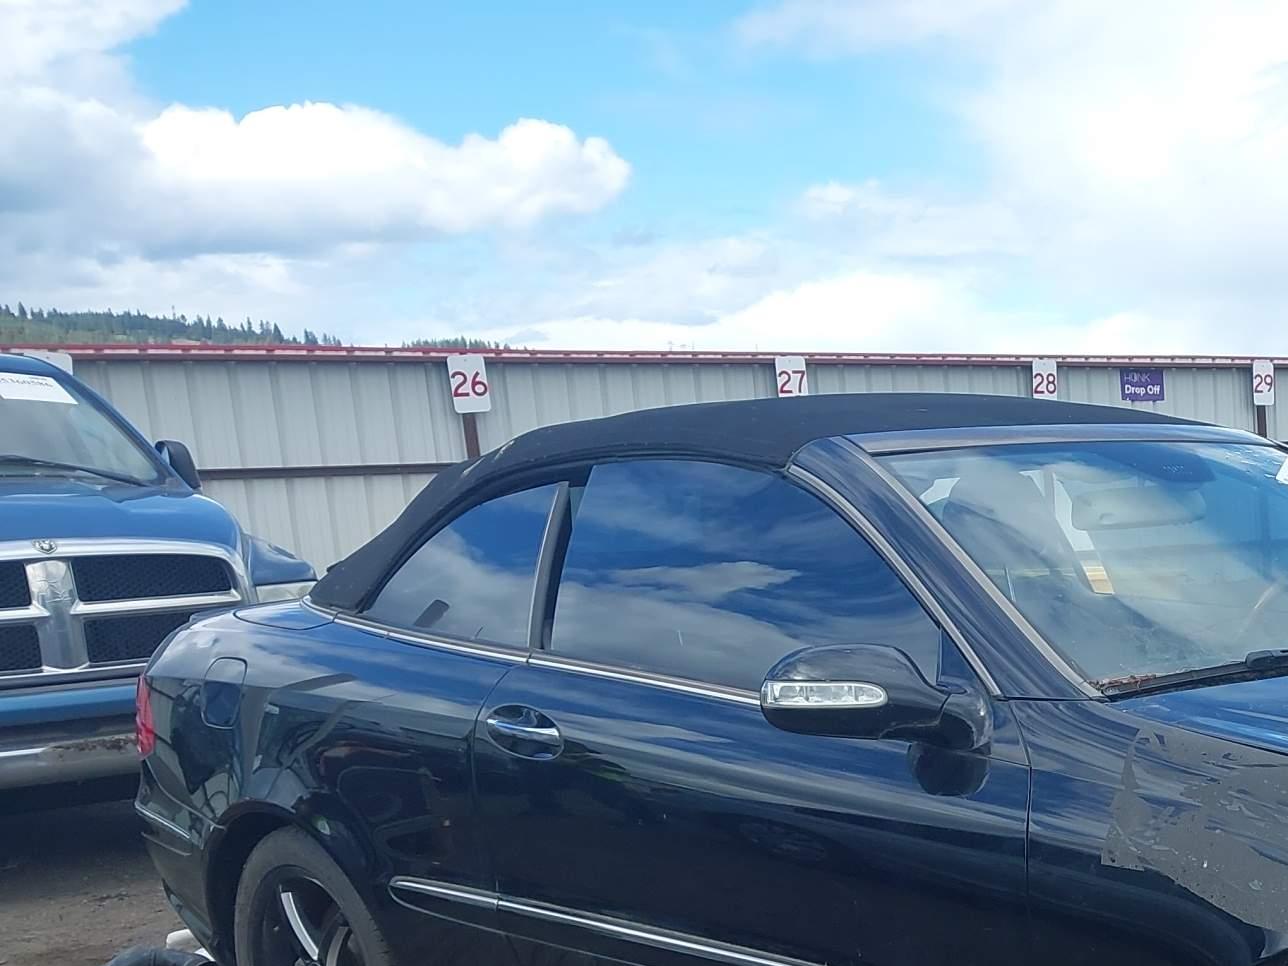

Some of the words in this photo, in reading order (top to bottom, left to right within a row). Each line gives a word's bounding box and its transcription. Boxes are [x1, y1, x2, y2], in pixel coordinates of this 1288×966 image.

[450, 370, 488, 397] 26
[777, 369, 806, 394] 27
[1033, 372, 1057, 394] 28
[1124, 384, 1146, 397] Drop
[1146, 384, 1161, 395] Off
[1253, 373, 1274, 394] 29
